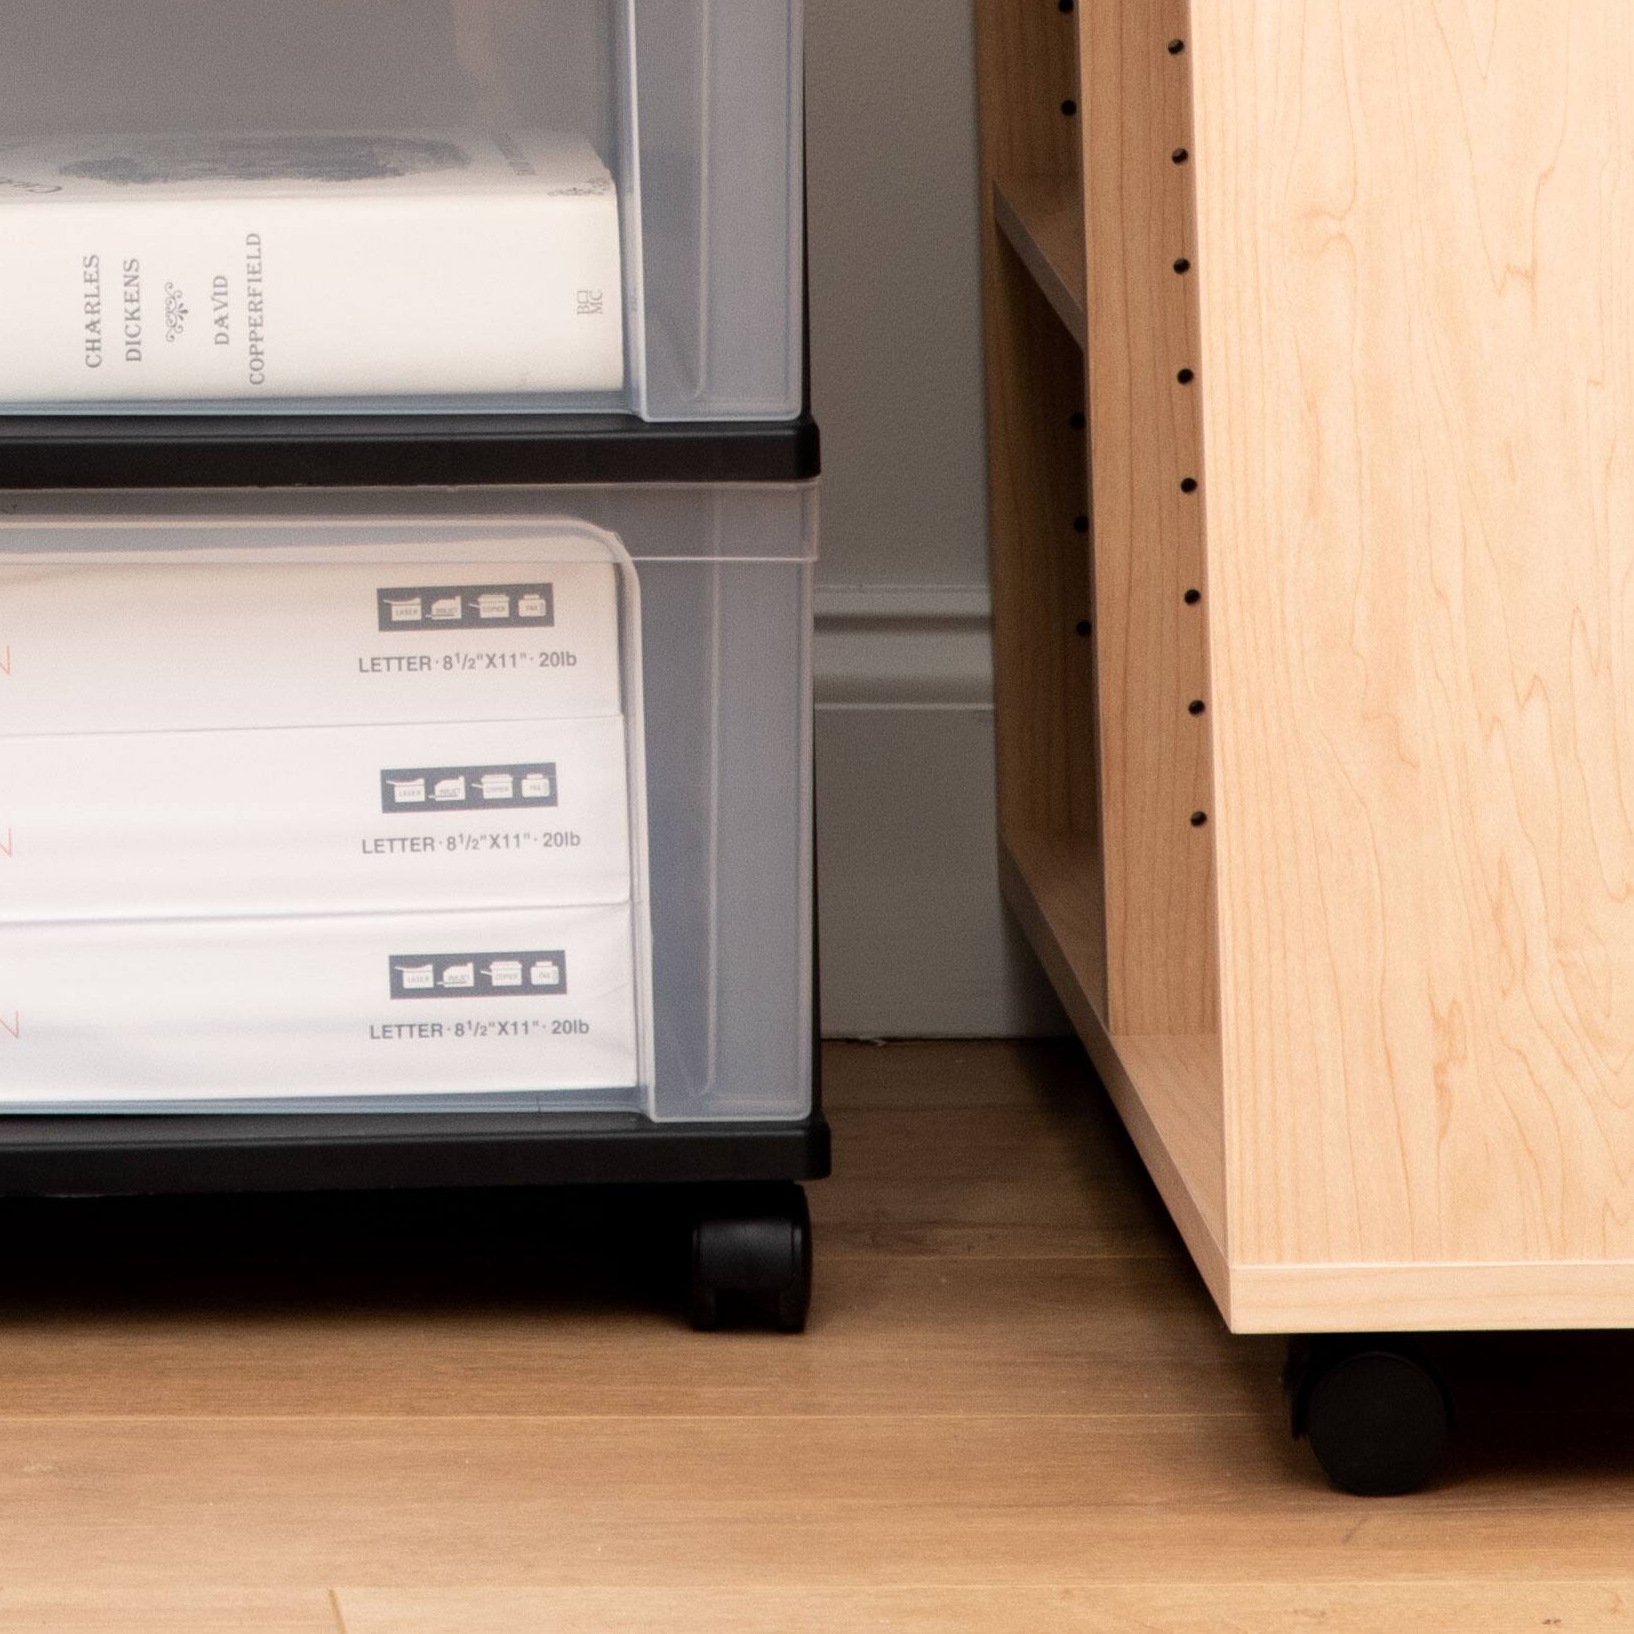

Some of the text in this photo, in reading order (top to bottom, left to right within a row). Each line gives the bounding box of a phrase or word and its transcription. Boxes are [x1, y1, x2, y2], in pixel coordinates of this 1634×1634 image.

[83, 254, 103, 369] CHARLES
[122, 258, 143, 363] DICKENS
[210, 275, 230, 346] DAVID
[245, 232, 265, 386] COPPERFIELD
